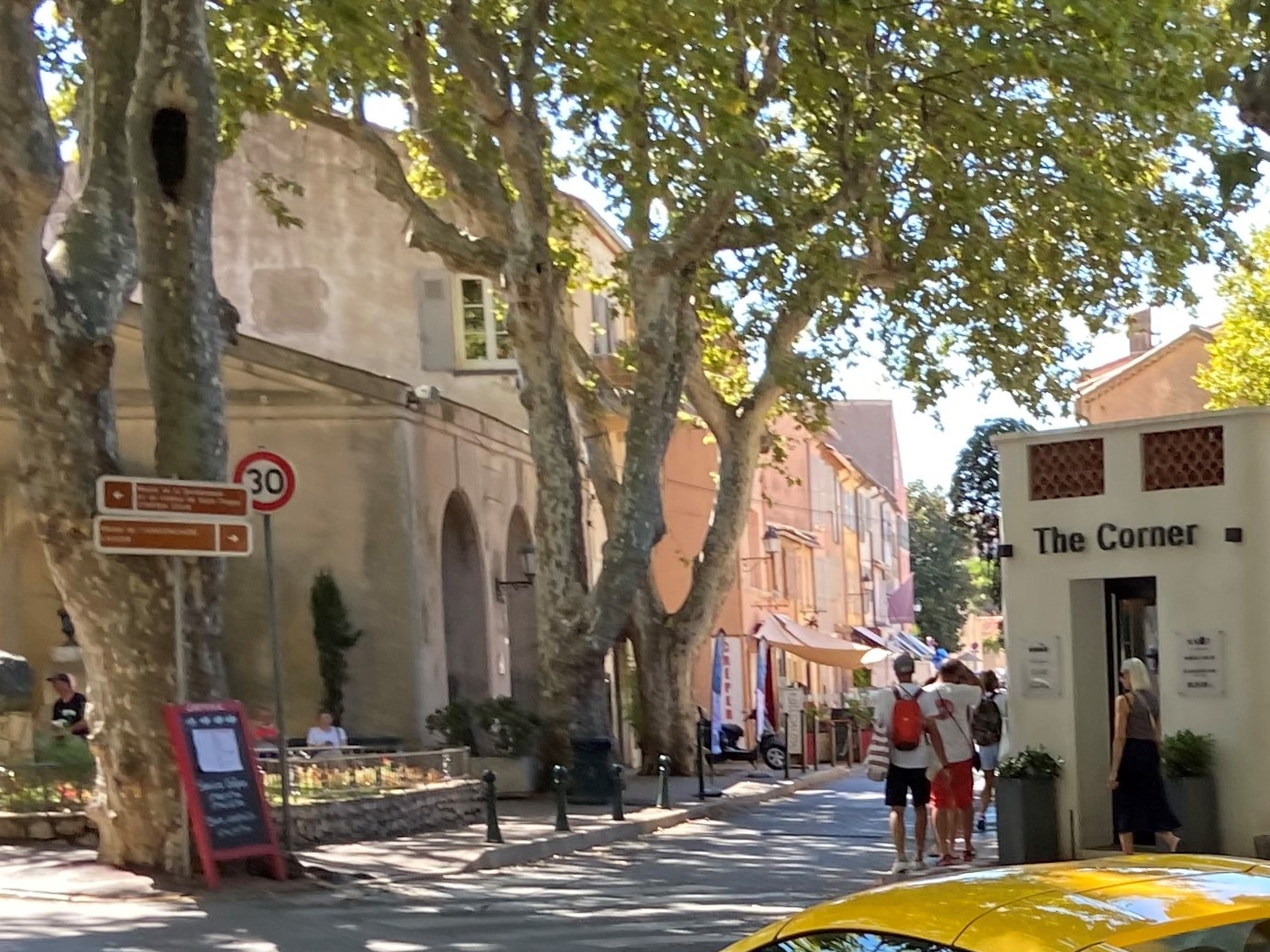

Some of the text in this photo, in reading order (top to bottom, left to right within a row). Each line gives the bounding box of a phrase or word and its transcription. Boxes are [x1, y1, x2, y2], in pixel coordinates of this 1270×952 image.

[247, 469, 284, 494] 30
[1033, 522, 1199, 555] The Corner
